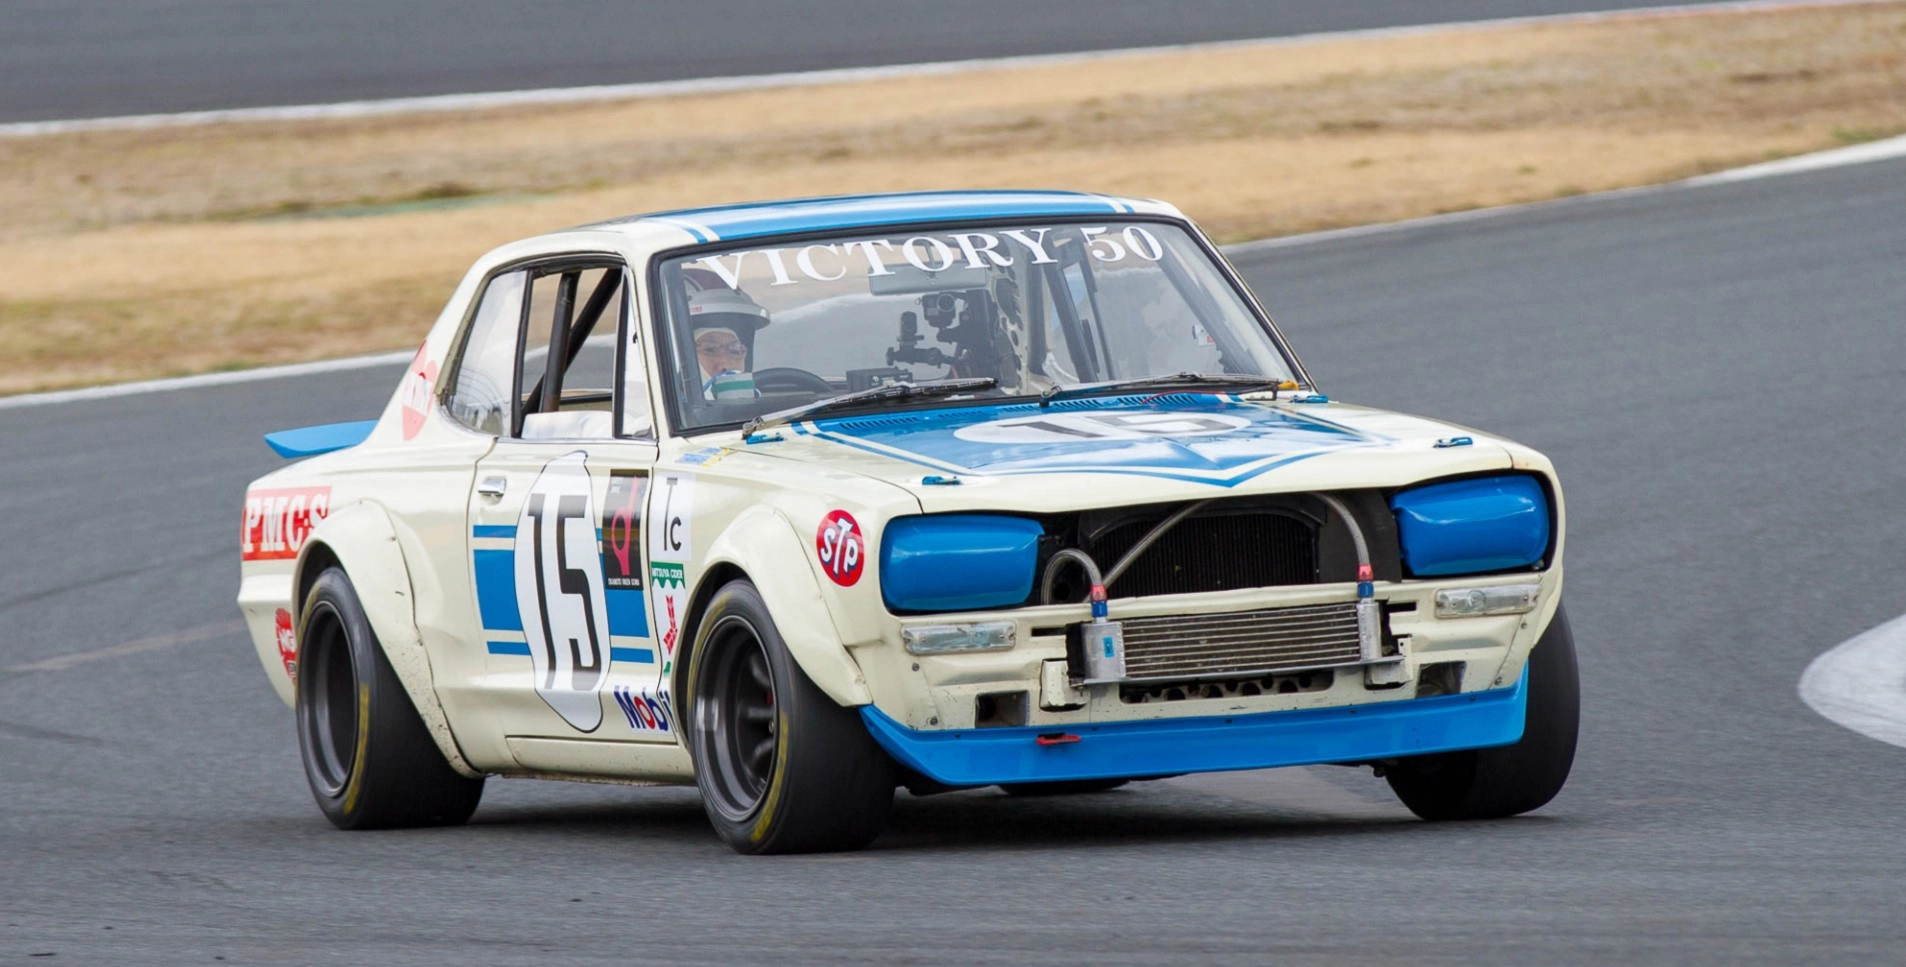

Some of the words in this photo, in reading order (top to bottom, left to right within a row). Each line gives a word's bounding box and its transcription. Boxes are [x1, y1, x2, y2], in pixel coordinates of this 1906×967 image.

[696, 227, 1059, 290] VICTORY
[1080, 225, 1163, 263] 50
[997, 411, 1238, 438] 15
[820, 517, 859, 576] STP
[527, 493, 602, 691] 15
